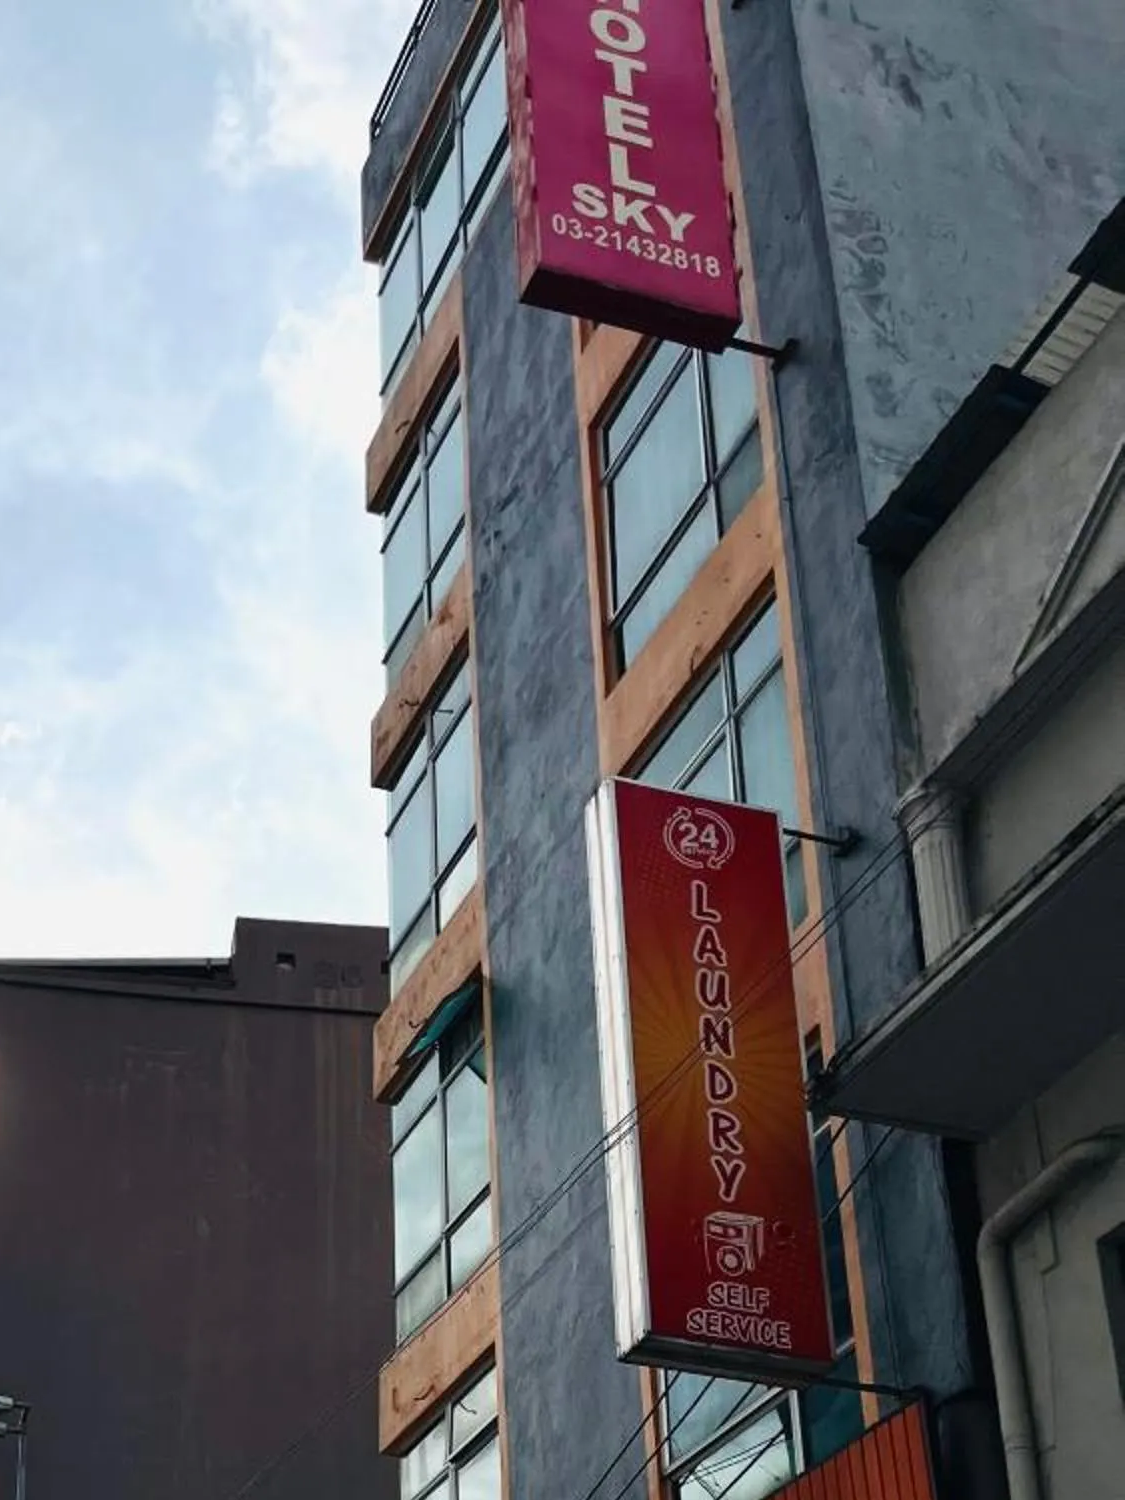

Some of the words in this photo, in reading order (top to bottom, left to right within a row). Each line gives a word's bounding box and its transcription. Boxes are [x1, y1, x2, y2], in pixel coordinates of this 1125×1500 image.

[572, 183, 697, 242] SKY
[552, 212, 721, 277] 03-21432818
[678, 822, 720, 850] 24
[691, 879, 748, 1202] LAUNDRY
[707, 1281, 771, 1316] SELF
[686, 1308, 792, 1350] SERVICE
